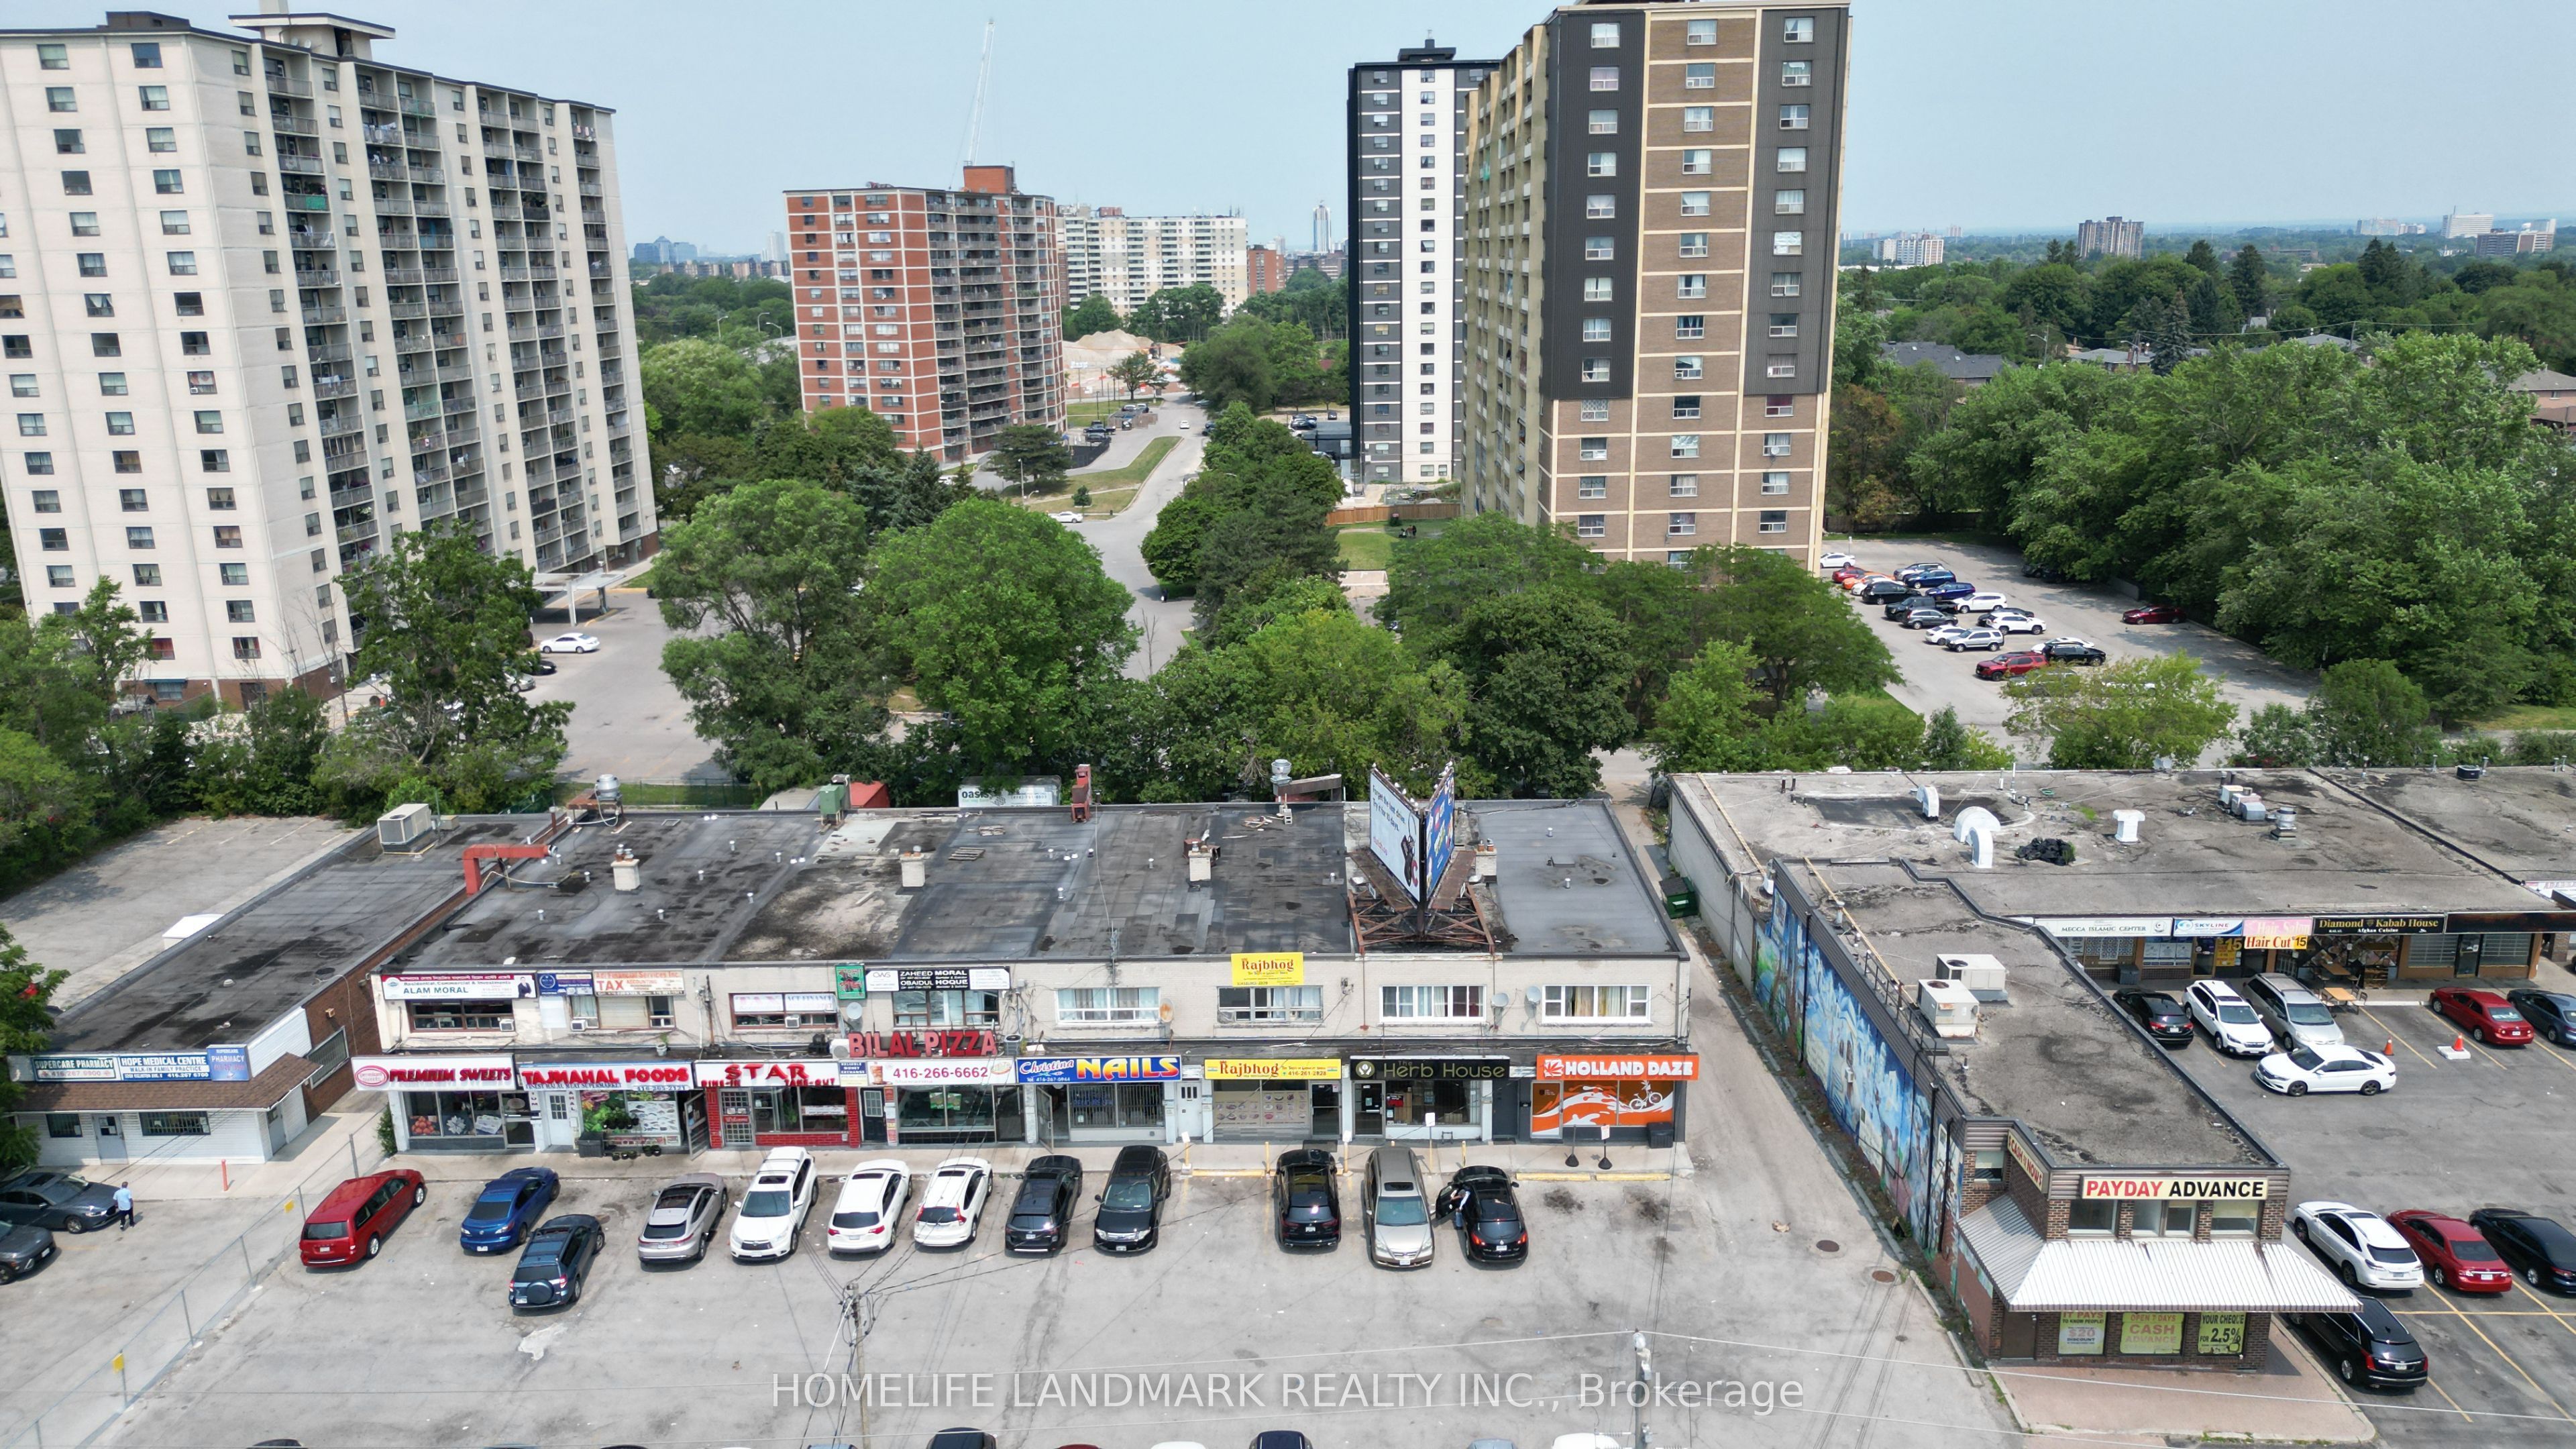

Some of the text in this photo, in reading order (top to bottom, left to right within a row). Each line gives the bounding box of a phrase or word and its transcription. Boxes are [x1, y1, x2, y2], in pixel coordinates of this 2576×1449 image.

[2319, 918, 2438, 928] Diamond Kabab House
[2246, 936, 2270, 947] Hair
[2273, 936, 2291, 948] Cut
[1242, 959, 1294, 972] Rajbhog
[596, 980, 624, 991] TAX
[848, 1030, 998, 1057] BILAL PIZZA
[35, 1060, 113, 1069] SUPERCARE PHARMACY
[121, 1056, 207, 1066] HOPE MEDICAL CENTRE
[460, 1067, 511, 1081] SWEETS
[522, 1067, 689, 1084] TAJMAHAL FOODS
[725, 1064, 810, 1079] STAR
[893, 1067, 988, 1079] 416-266-6662
[1020, 1060, 1074, 1074] Christina
[1076, 1057, 1179, 1081] NAILS
[1220, 1063, 1279, 1077] Rajbhog
[1384, 1063, 1505, 1078] Herb House
[1565, 1061, 1693, 1076] HOLLAND DAZE
[784, 1077, 835, 1087] TAKE-OUT
[2012, 1140, 2023, 1163] CASH
[2027, 1159, 2039, 1183] NOW
[2086, 1180, 2264, 1197] PAYDAY ADVANCE
[2202, 1315, 2218, 1324] YOUR
[2129, 1324, 2175, 1334] CASH
[2210, 1328, 2241, 1343] 2.5%
